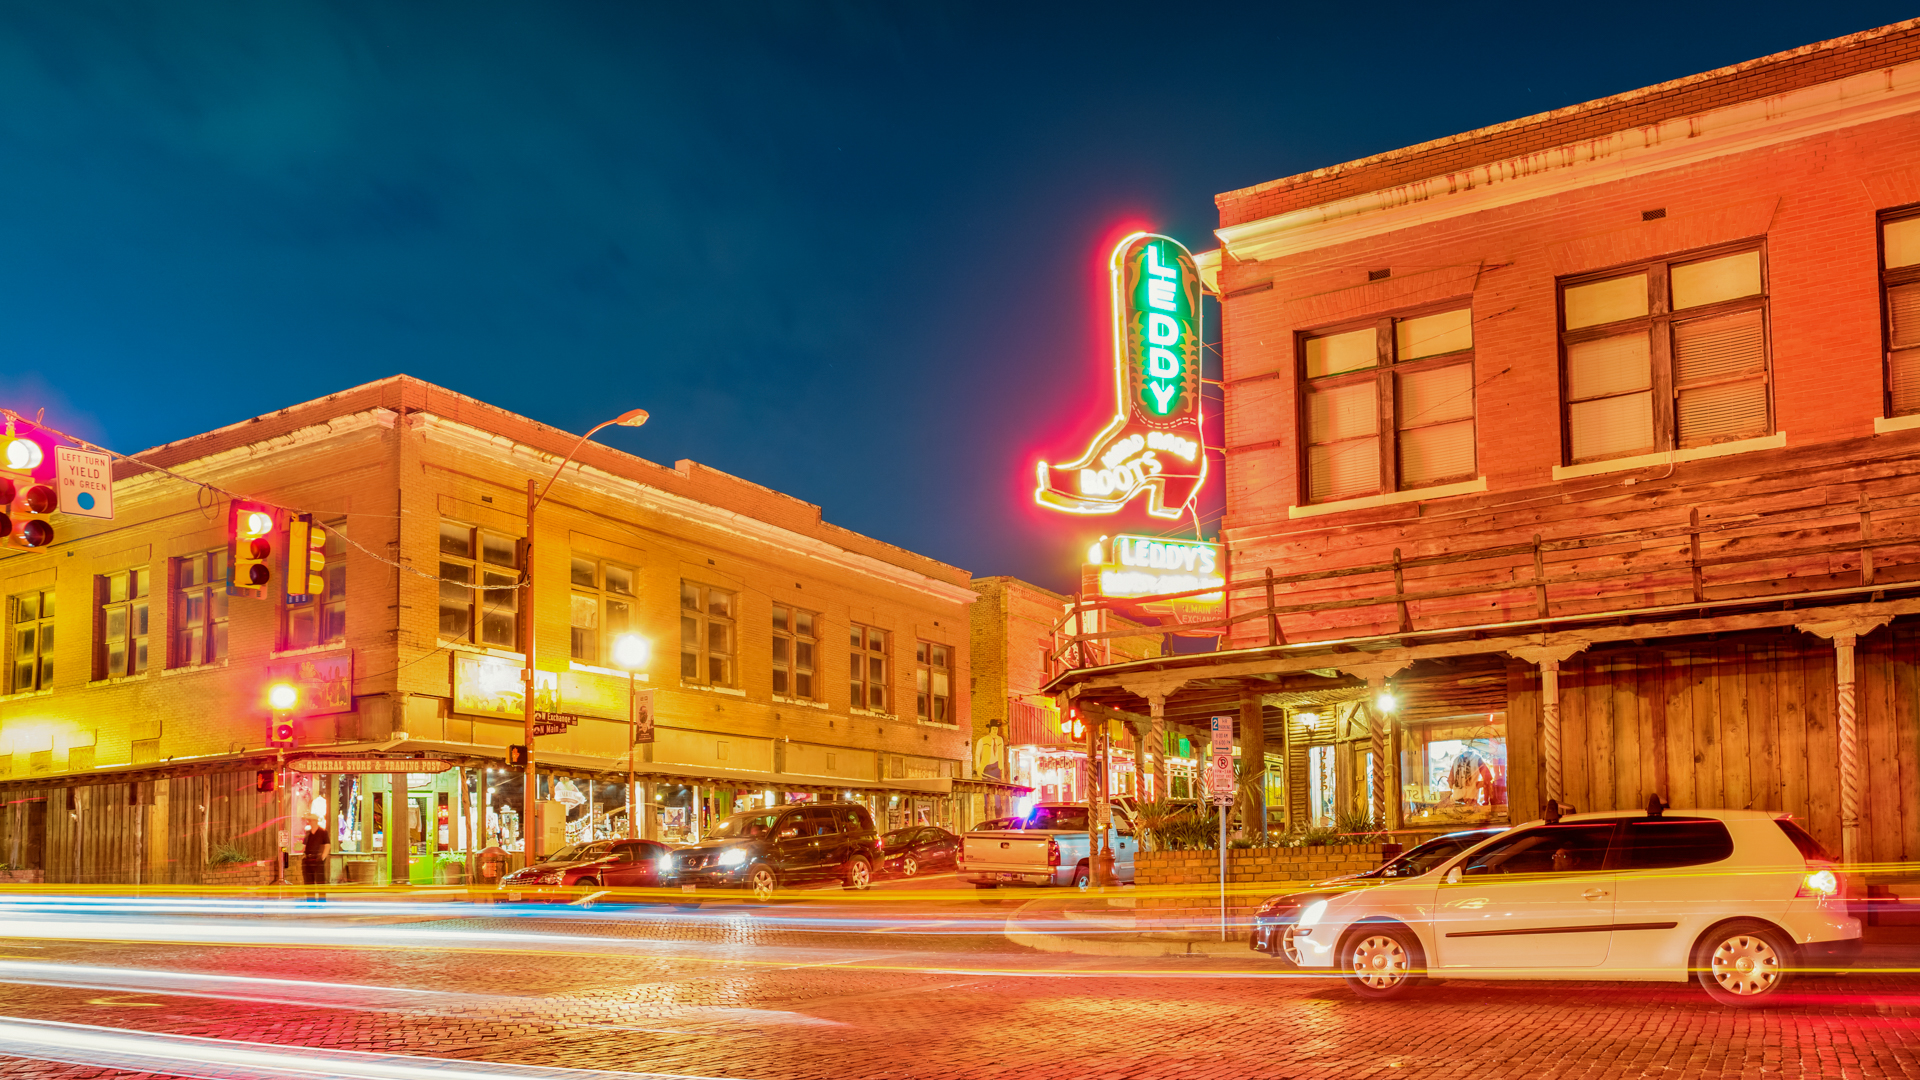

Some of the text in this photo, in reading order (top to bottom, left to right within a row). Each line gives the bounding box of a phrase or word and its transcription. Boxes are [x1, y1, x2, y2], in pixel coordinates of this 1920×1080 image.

[1147, 245, 1180, 414] LEDDY
[61, 453, 106, 467] LEFT TURN
[69, 465, 100, 479] YIELD
[1080, 450, 1162, 496] BOOTS
[63, 478, 107, 491] ON GREEN
[1121, 538, 1217, 573] LEDDY'S
[547, 712, 571, 723] Exchange
[1213, 719, 1218, 729] 2
[540, 725, 545, 734] N
[546, 724, 559, 734] Main
[306, 760, 343, 771] GENERAL
[346, 760, 371, 771] STORE
[375, 761, 381, 770] &
[385, 760, 419, 771] TRADING
[422, 760, 441, 771] POST
[1319, 751, 1328, 791] 2455
